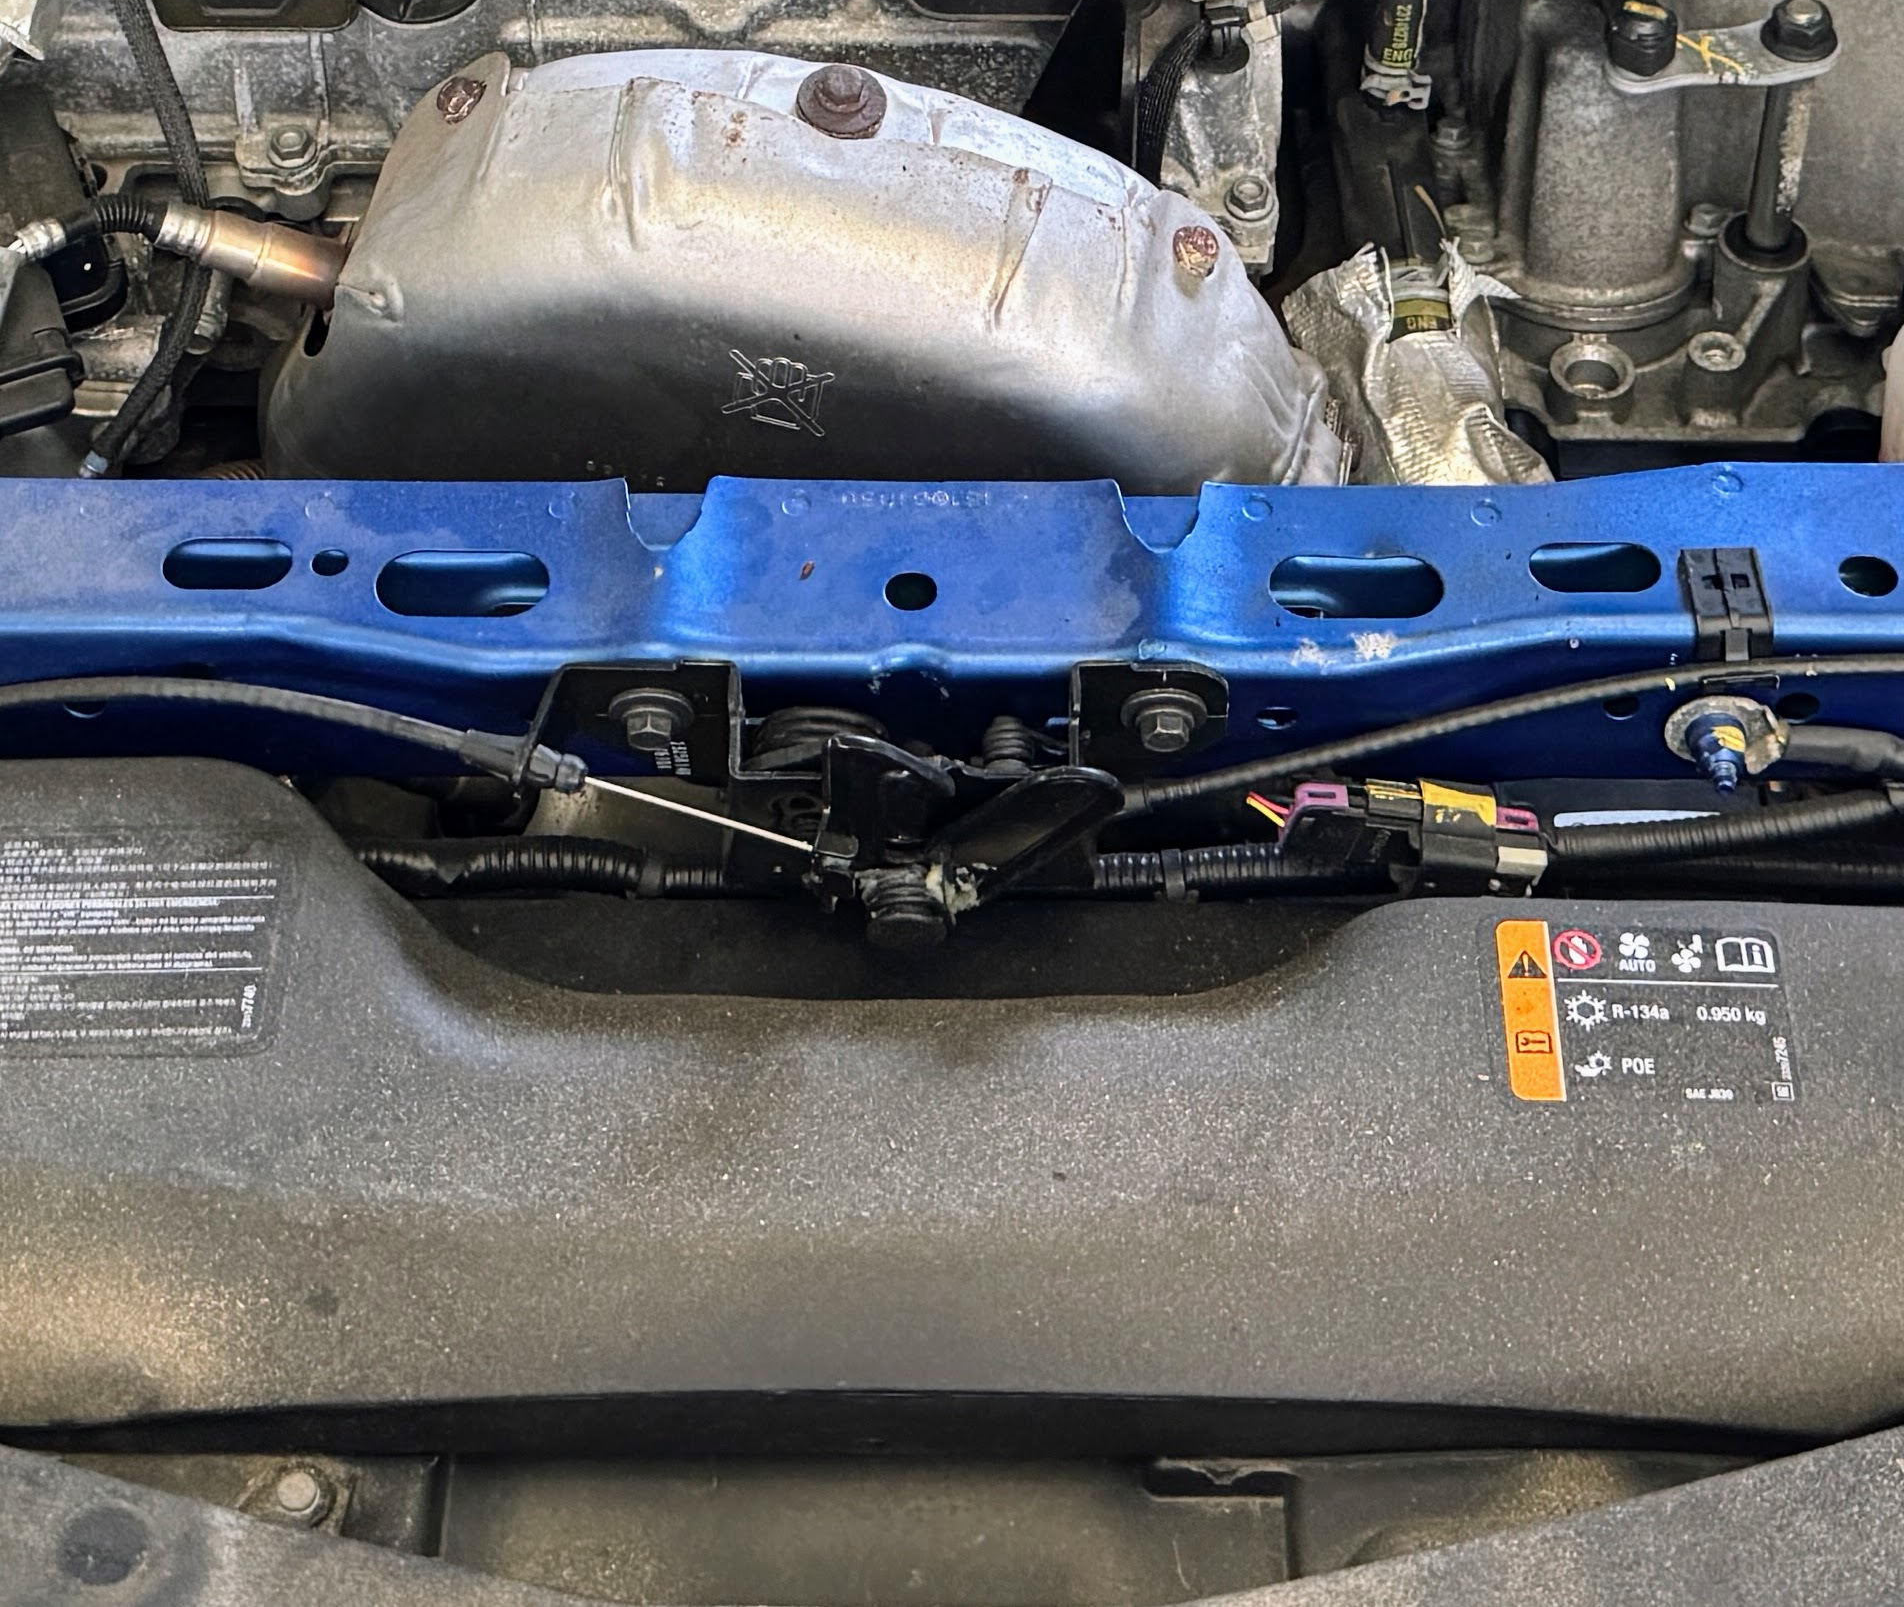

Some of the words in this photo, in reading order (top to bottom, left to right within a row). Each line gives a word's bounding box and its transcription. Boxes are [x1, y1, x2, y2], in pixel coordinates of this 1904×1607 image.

[1618, 958, 1657, 973] AUTO
[1611, 1003, 1671, 1021] R-134a
[1696, 1005, 1741, 1023] 0.950
[1744, 1006, 1768, 1026] kg
[1621, 1057, 1656, 1075] POE
